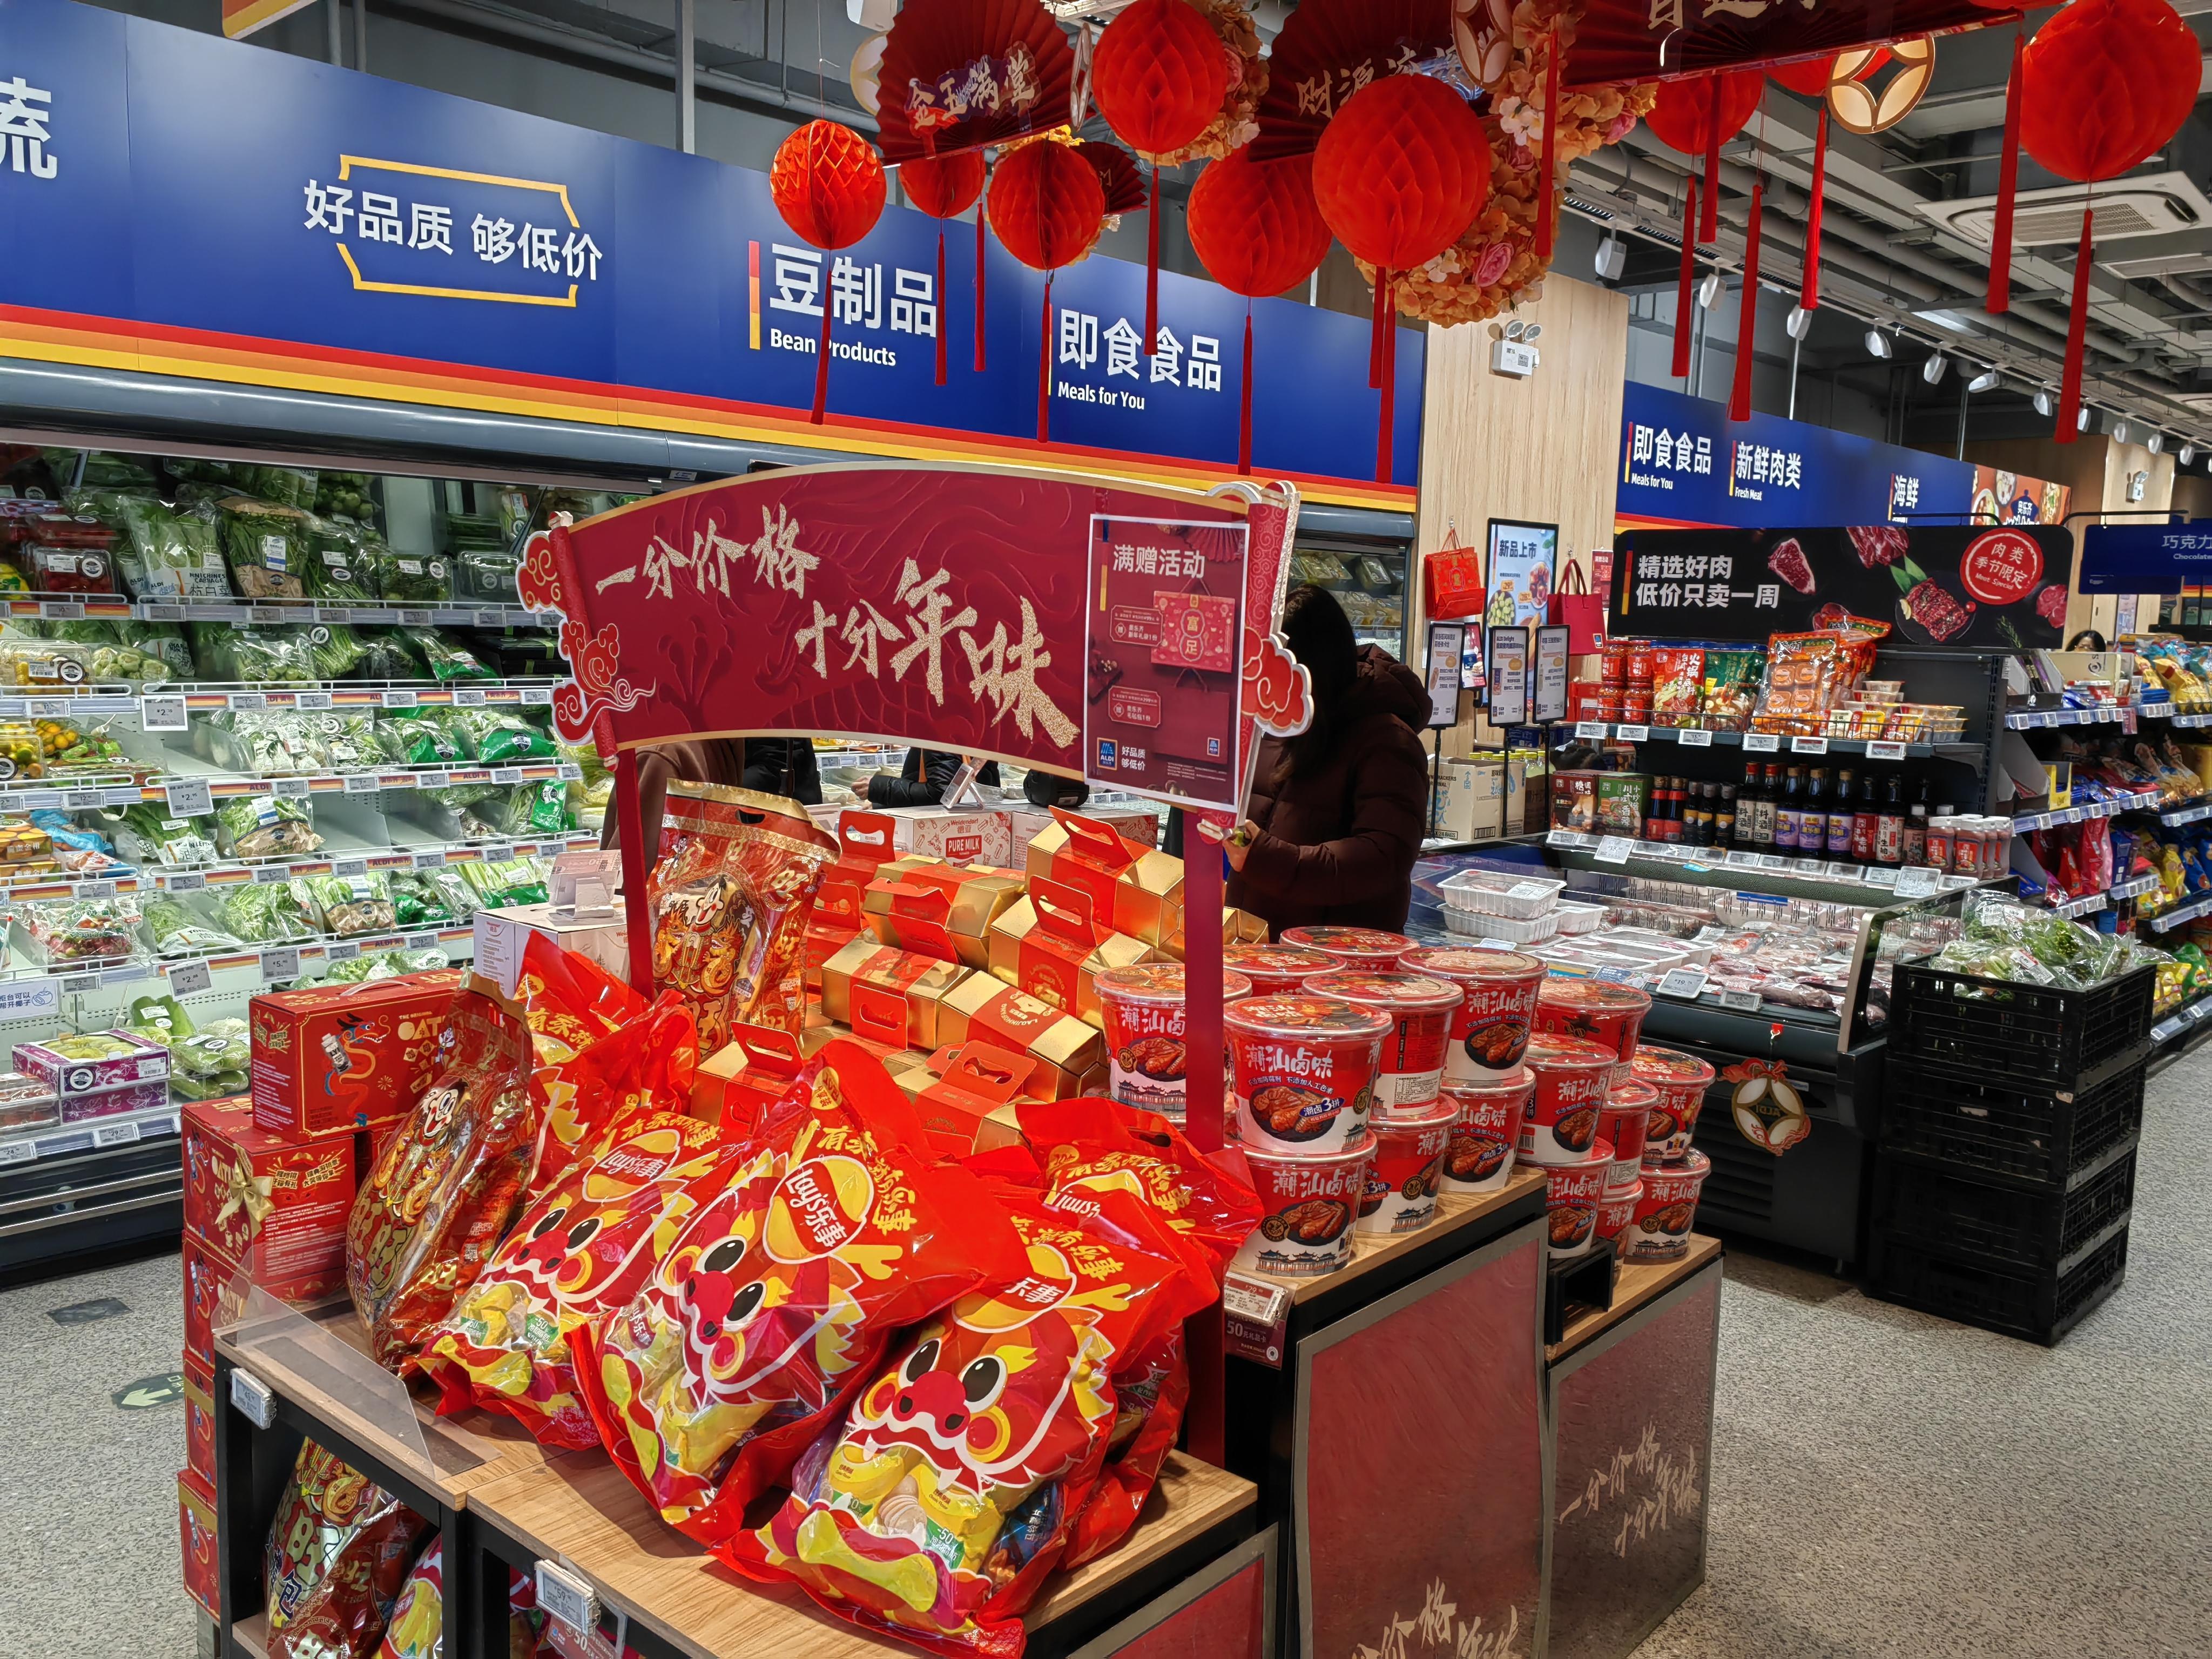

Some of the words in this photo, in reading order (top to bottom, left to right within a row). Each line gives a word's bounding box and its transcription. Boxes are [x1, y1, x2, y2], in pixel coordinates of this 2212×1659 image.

[304, 179, 454, 255] 好品质
[470, 213, 603, 281] 够低价
[769, 242, 938, 338] 豆制品
[770, 328, 816, 354] Bean
[1058, 308, 1222, 393] 即食食品
[1057, 381, 1097, 403] Meals
[1098, 386, 1117, 405] for
[1120, 391, 1145, 410] You
[1631, 424, 1713, 476] 即食食品
[1735, 441, 1802, 490] 新鲜肉类
[1630, 473, 1650, 488] Meals
[1650, 475, 1660, 488] for
[1661, 477, 1674, 491] You
[1734, 486, 1750, 500] Fresh
[1750, 488, 1763, 502] Meat
[1893, 474, 1919, 509] 海鲜
[595, 503, 822, 600] 一分价格
[1499, 539, 1537, 559] 新品上市
[2161, 534, 2212, 550] 巧克力
[1112, 543, 1206, 579] 满赠活动
[1637, 554, 1733, 580] 精选好肉
[1973, 556, 2028, 590] 季节限定
[1974, 572, 1991, 584] Meat
[1992, 577, 2014, 591] Special
[1636, 583, 1781, 609] 低价只卖一周
[794, 557, 1081, 748] 十分年味
[1100, 754, 1114, 763] ALDI
[1121, 745, 1146, 759] 好品质
[1121, 758, 1146, 772] 够低价
[947, 839, 965, 852] PURE
[965, 838, 981, 851] MILK
[397, 1015, 447, 1041] OAT
[1120, 1006, 1186, 1035] 潮汕卤
[1244, 1044, 1333, 1079] 潮汕卤味
[1303, 1096, 1341, 1117] 潮卤3拼
[1657, 1089, 1688, 1110] 卤味
[1453, 1103, 1507, 1127] 汕卤味
[597, 1150, 638, 1175] Lay's
[626, 1157, 668, 1179] 乐事
[785, 1168, 830, 1214] Lay's
[804, 1206, 848, 1247] 乐事
